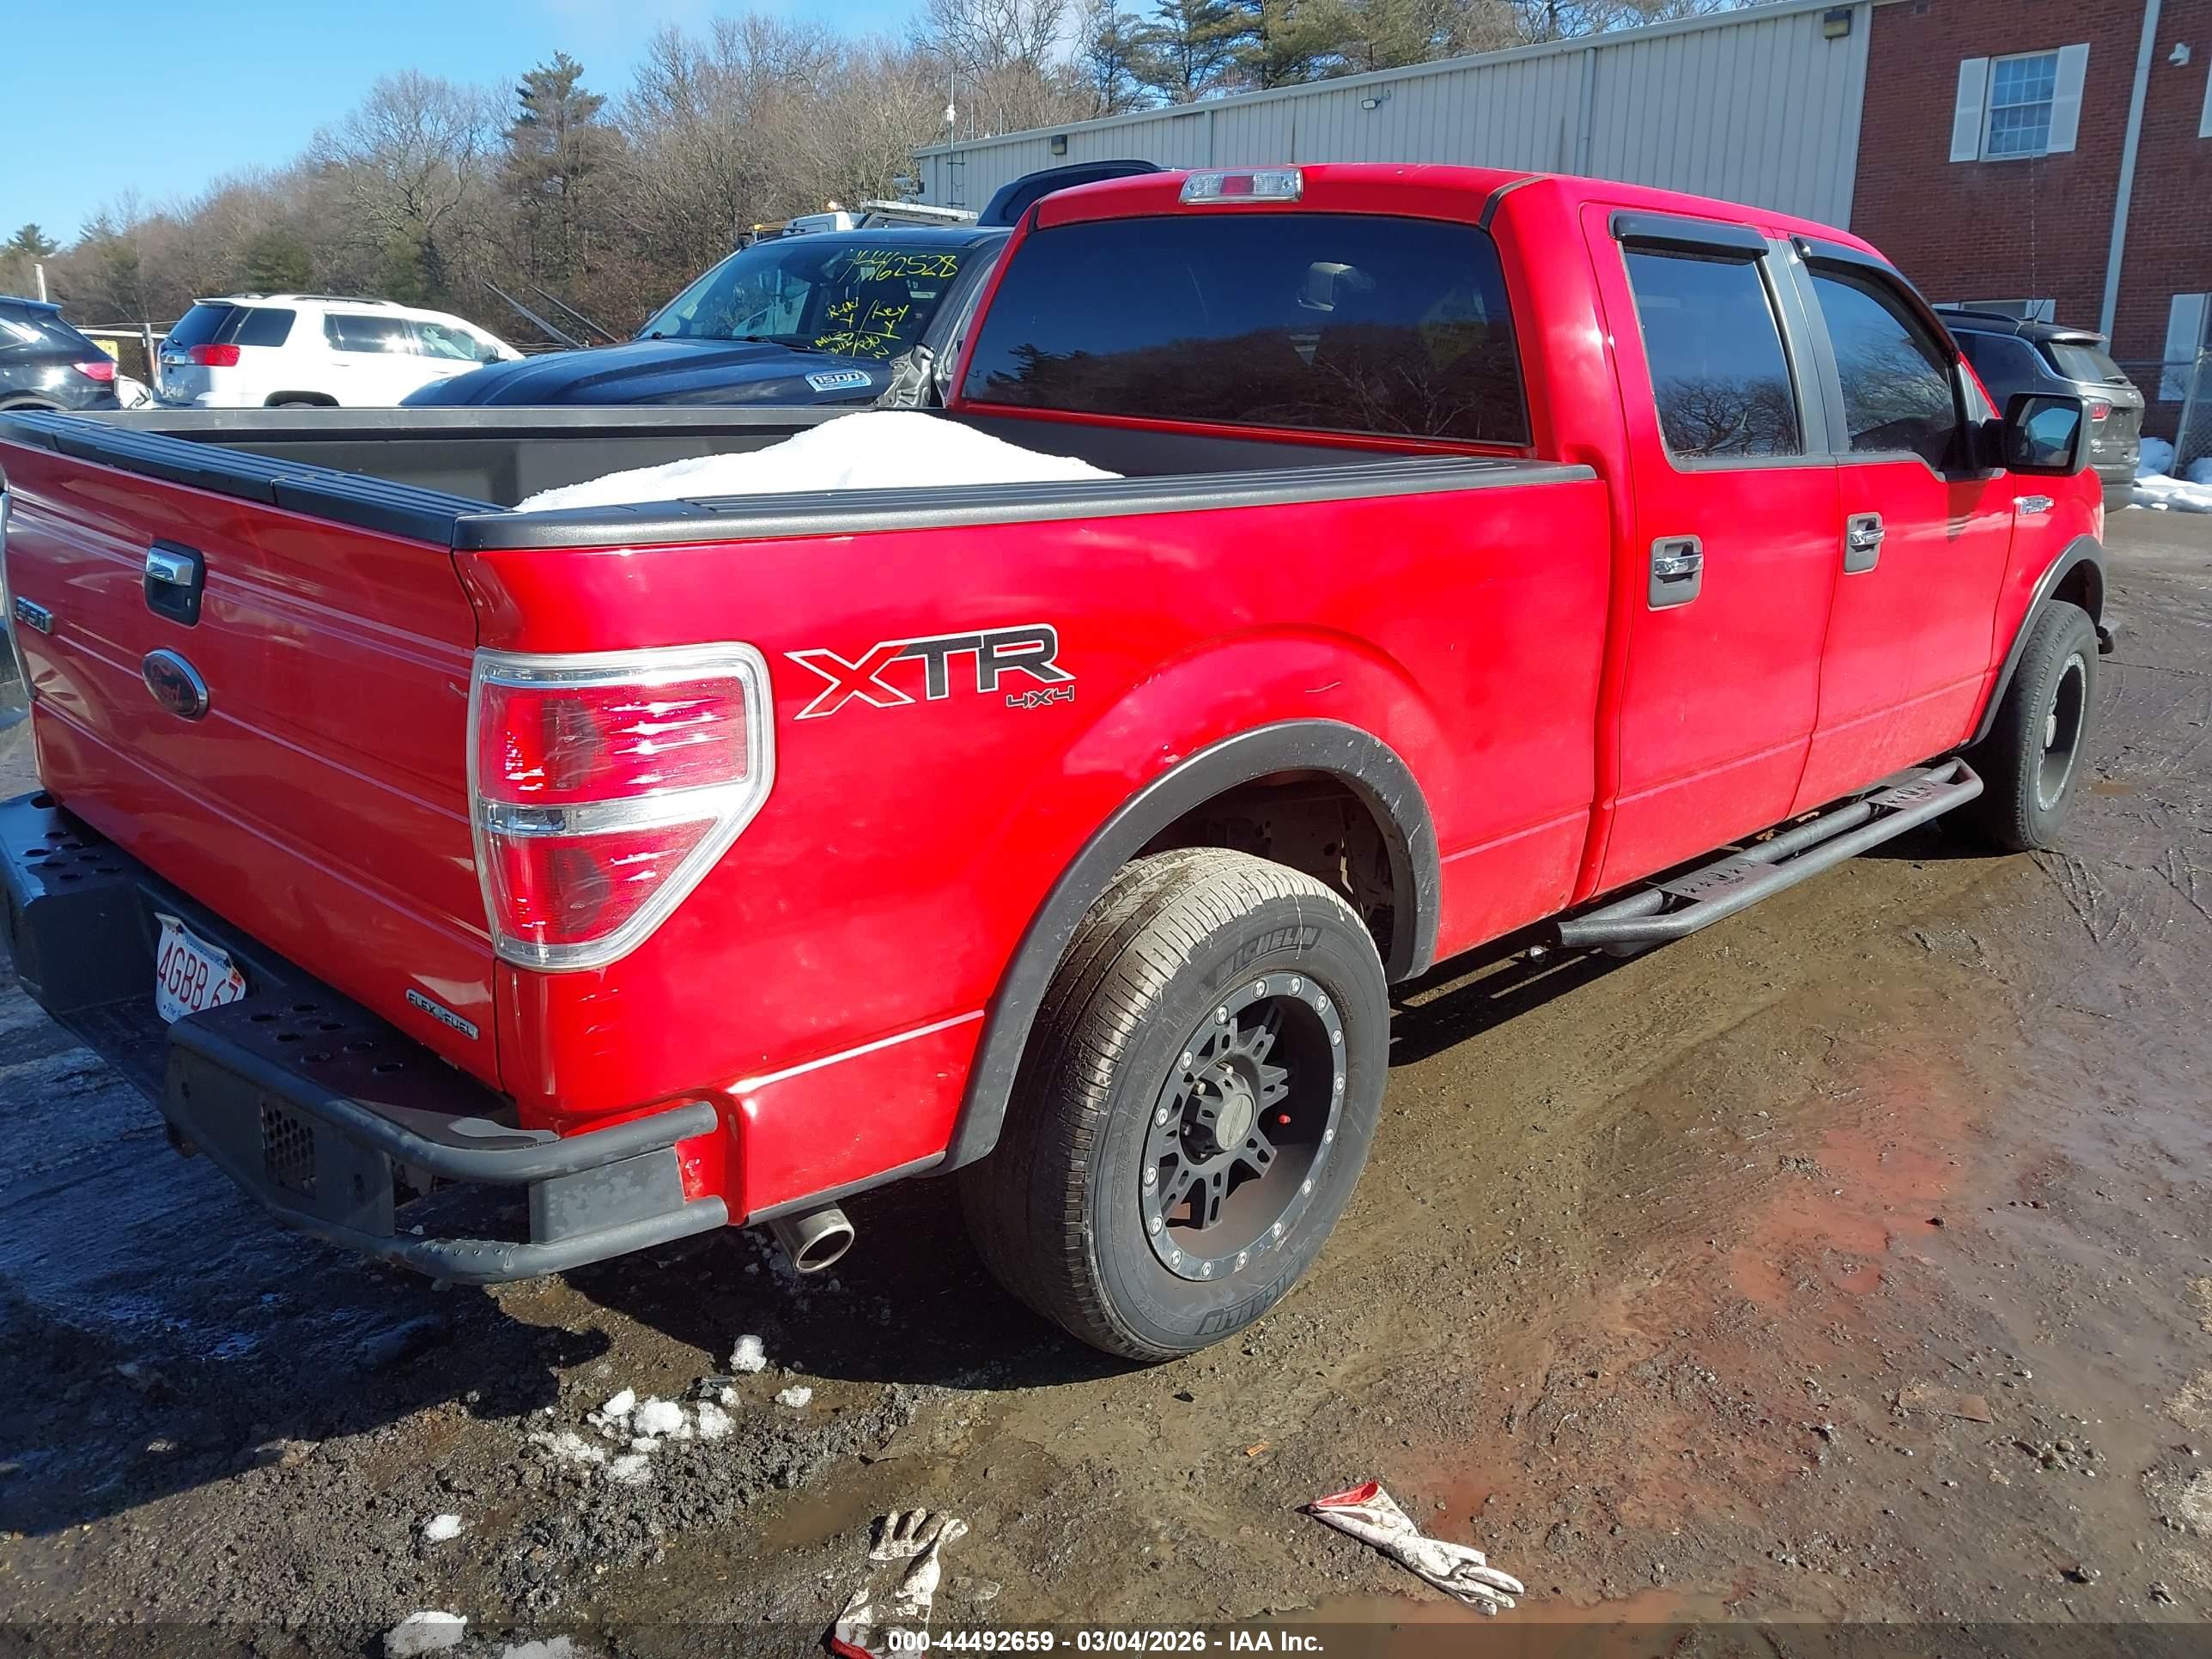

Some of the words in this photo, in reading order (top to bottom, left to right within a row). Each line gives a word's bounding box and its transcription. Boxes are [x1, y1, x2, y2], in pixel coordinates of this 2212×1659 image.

[815, 373, 860, 384] 1500
[783, 623, 1077, 720] XTR
[408, 992, 436, 1017] FLEX
[444, 1013, 476, 1038] FUEL
